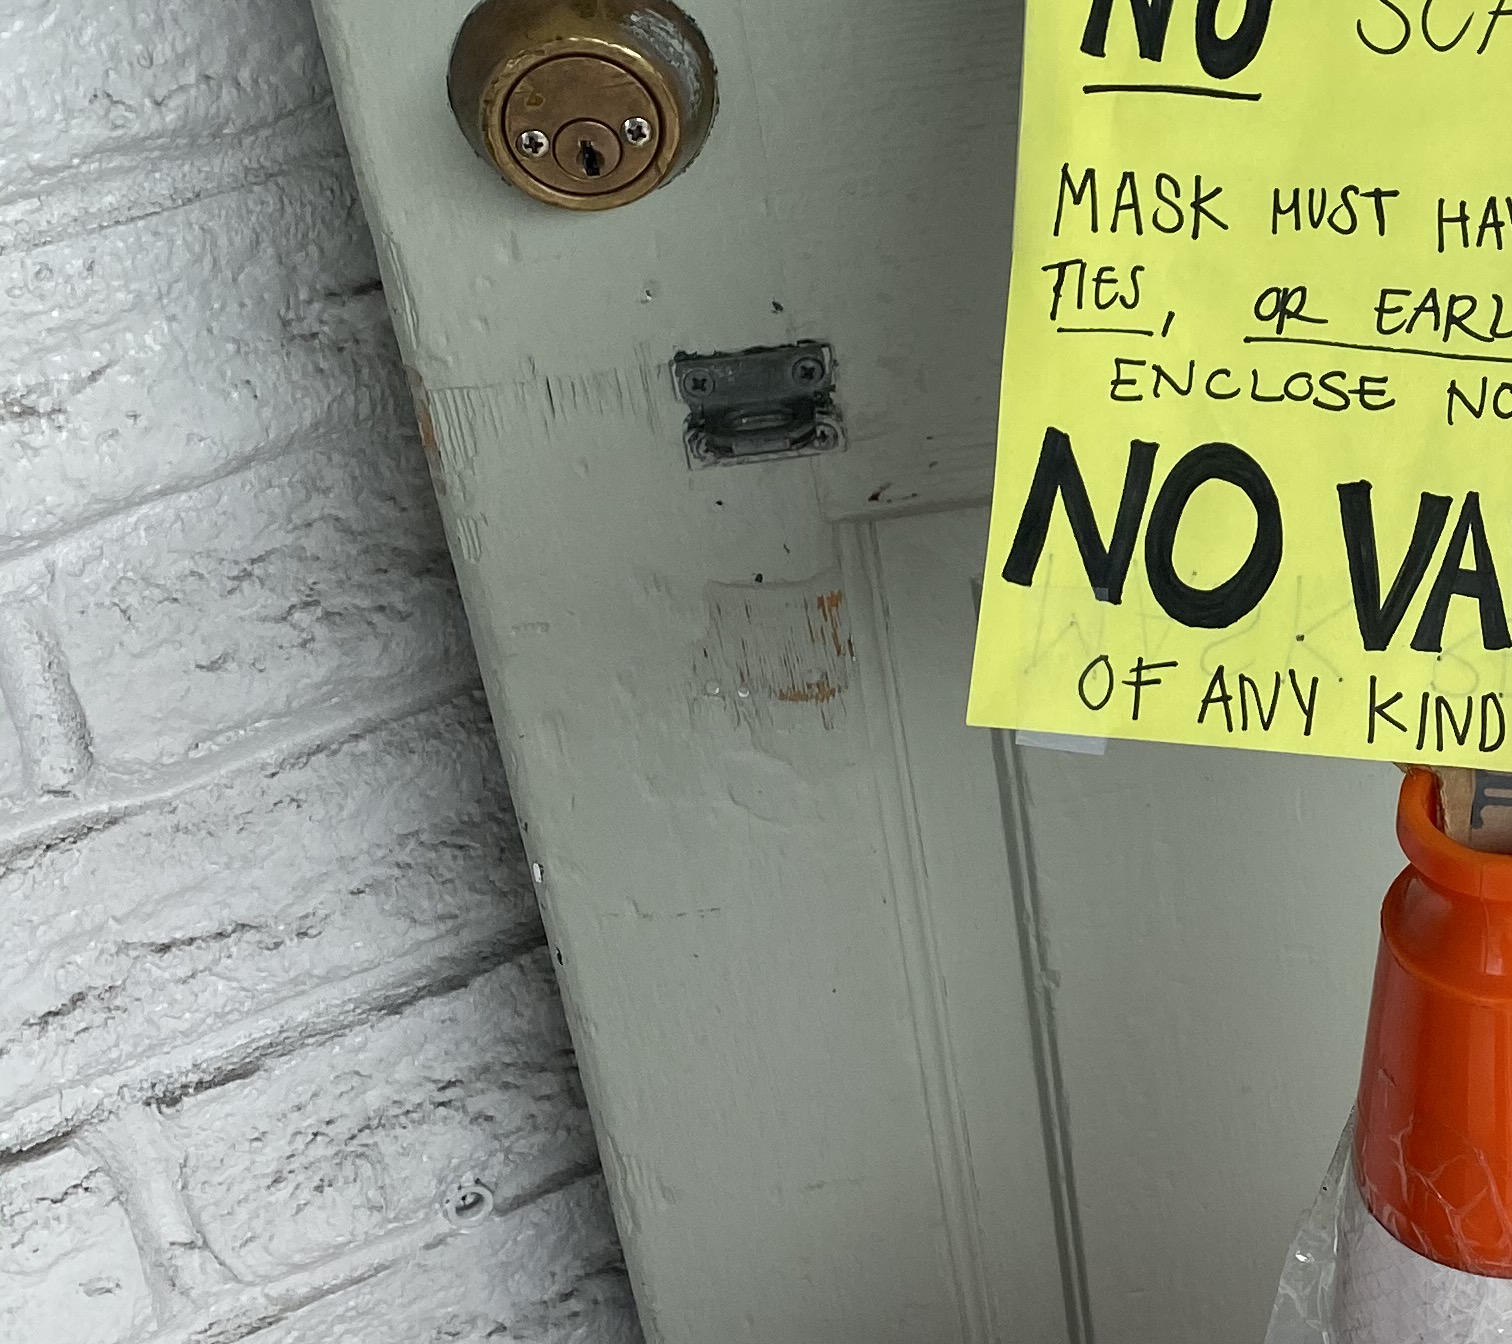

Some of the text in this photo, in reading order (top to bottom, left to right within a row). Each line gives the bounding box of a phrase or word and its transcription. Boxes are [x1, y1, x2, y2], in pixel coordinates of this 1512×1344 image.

[1053, 163, 1228, 240] MASK
[1272, 185, 1399, 236] MUST
[1041, 259, 1175, 337] TIES,
[1254, 286, 1328, 326] OR
[1111, 358, 1395, 411] ENCLOSE
[1002, 427, 1283, 629] NO
[1078, 655, 1178, 720] OF
[1198, 672, 1318, 736] ANY
[1368, 690, 1507, 753] KIND
